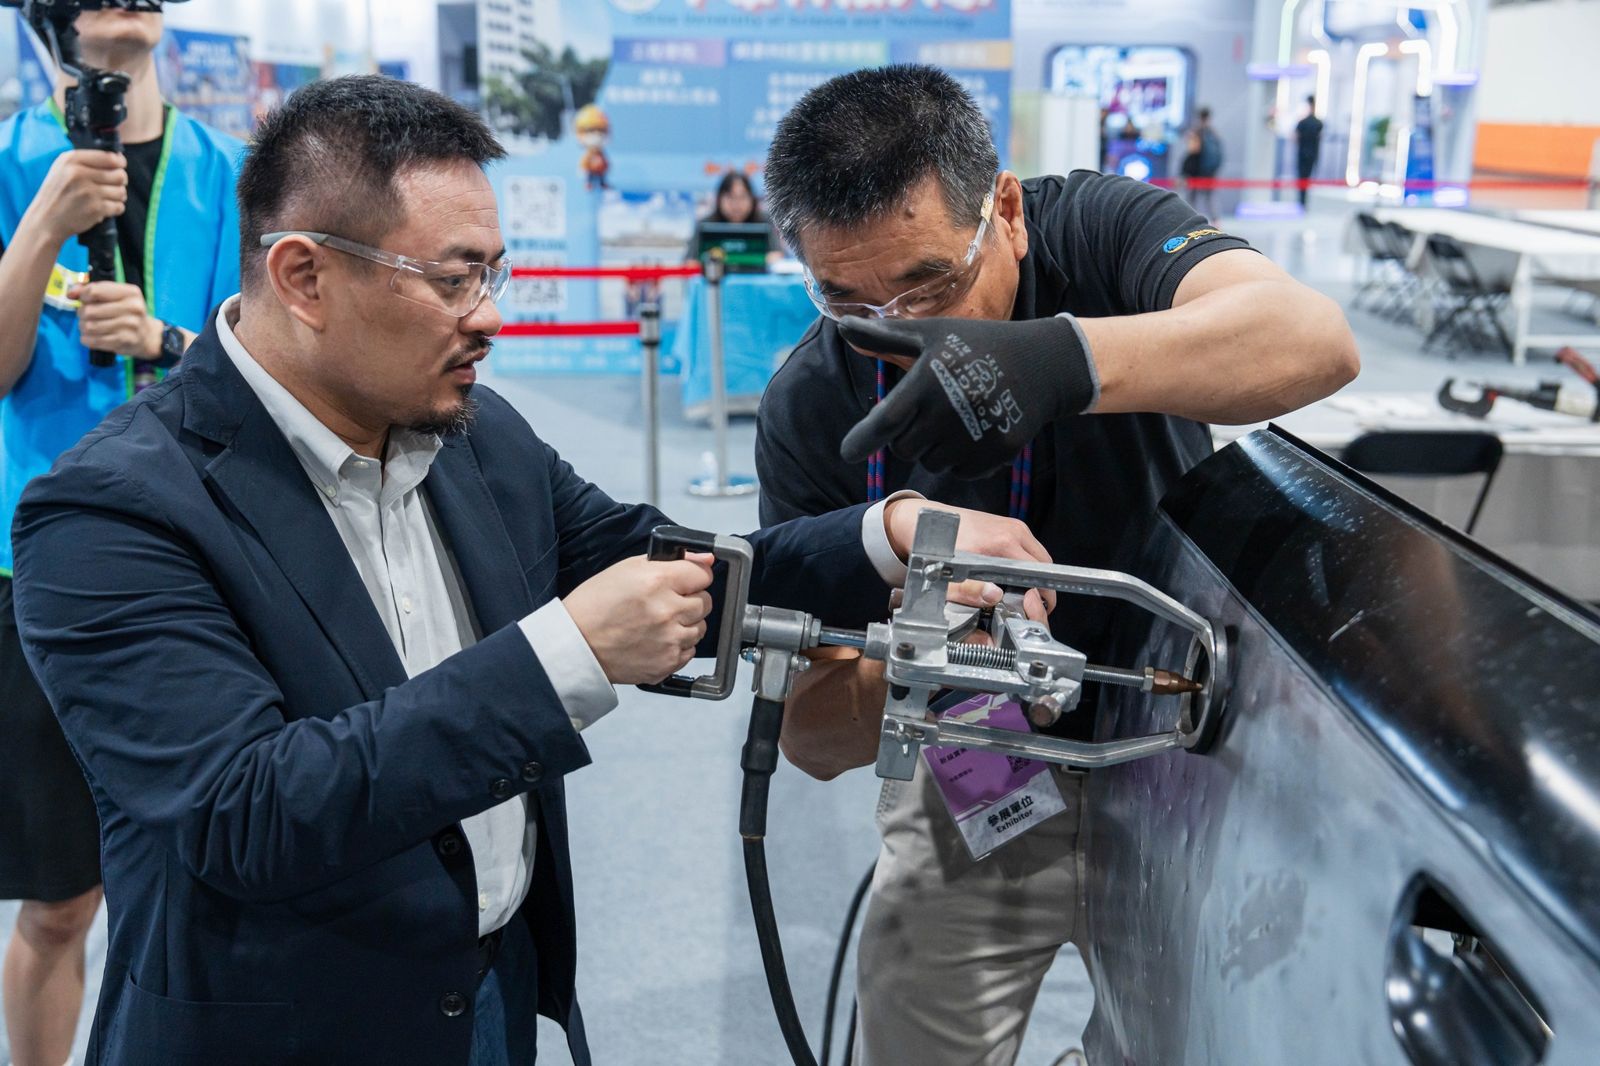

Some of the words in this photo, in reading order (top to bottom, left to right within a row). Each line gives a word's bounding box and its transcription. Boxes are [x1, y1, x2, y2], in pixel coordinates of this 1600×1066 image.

[987, 795, 1034, 827] 參展單位
[996, 809, 1033, 833] Exhibitor
